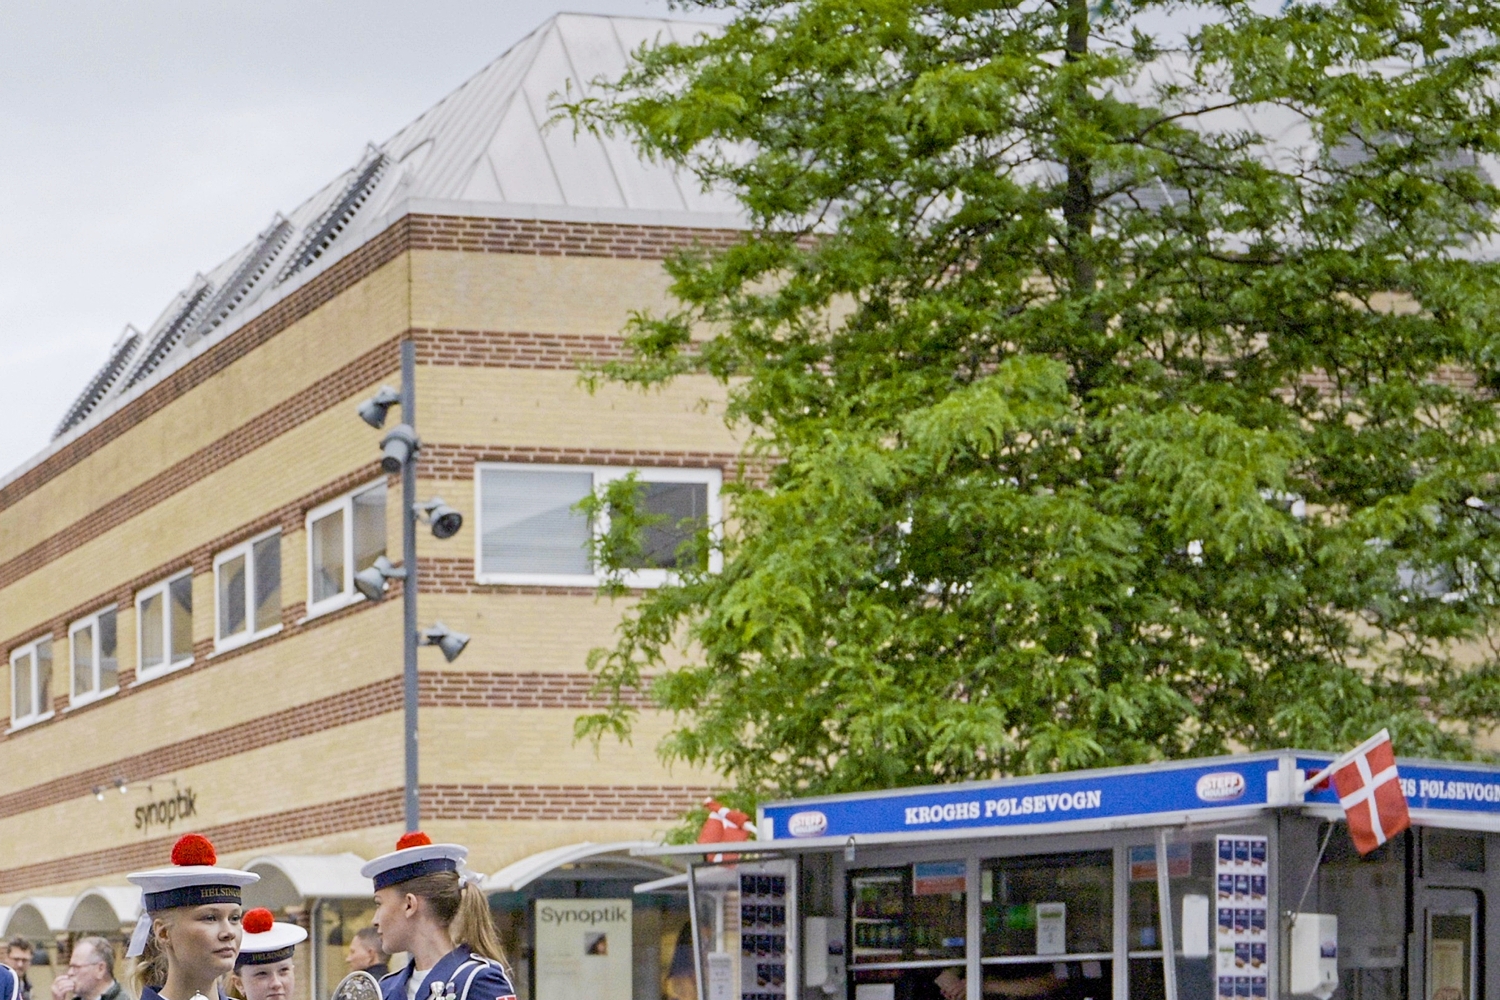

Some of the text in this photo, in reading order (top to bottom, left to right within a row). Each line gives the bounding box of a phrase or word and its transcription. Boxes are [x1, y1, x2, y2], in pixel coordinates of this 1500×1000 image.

[905, 790, 1102, 825] KROGHS PØLSEVOGN
[541, 906, 627, 926] Synoptik
